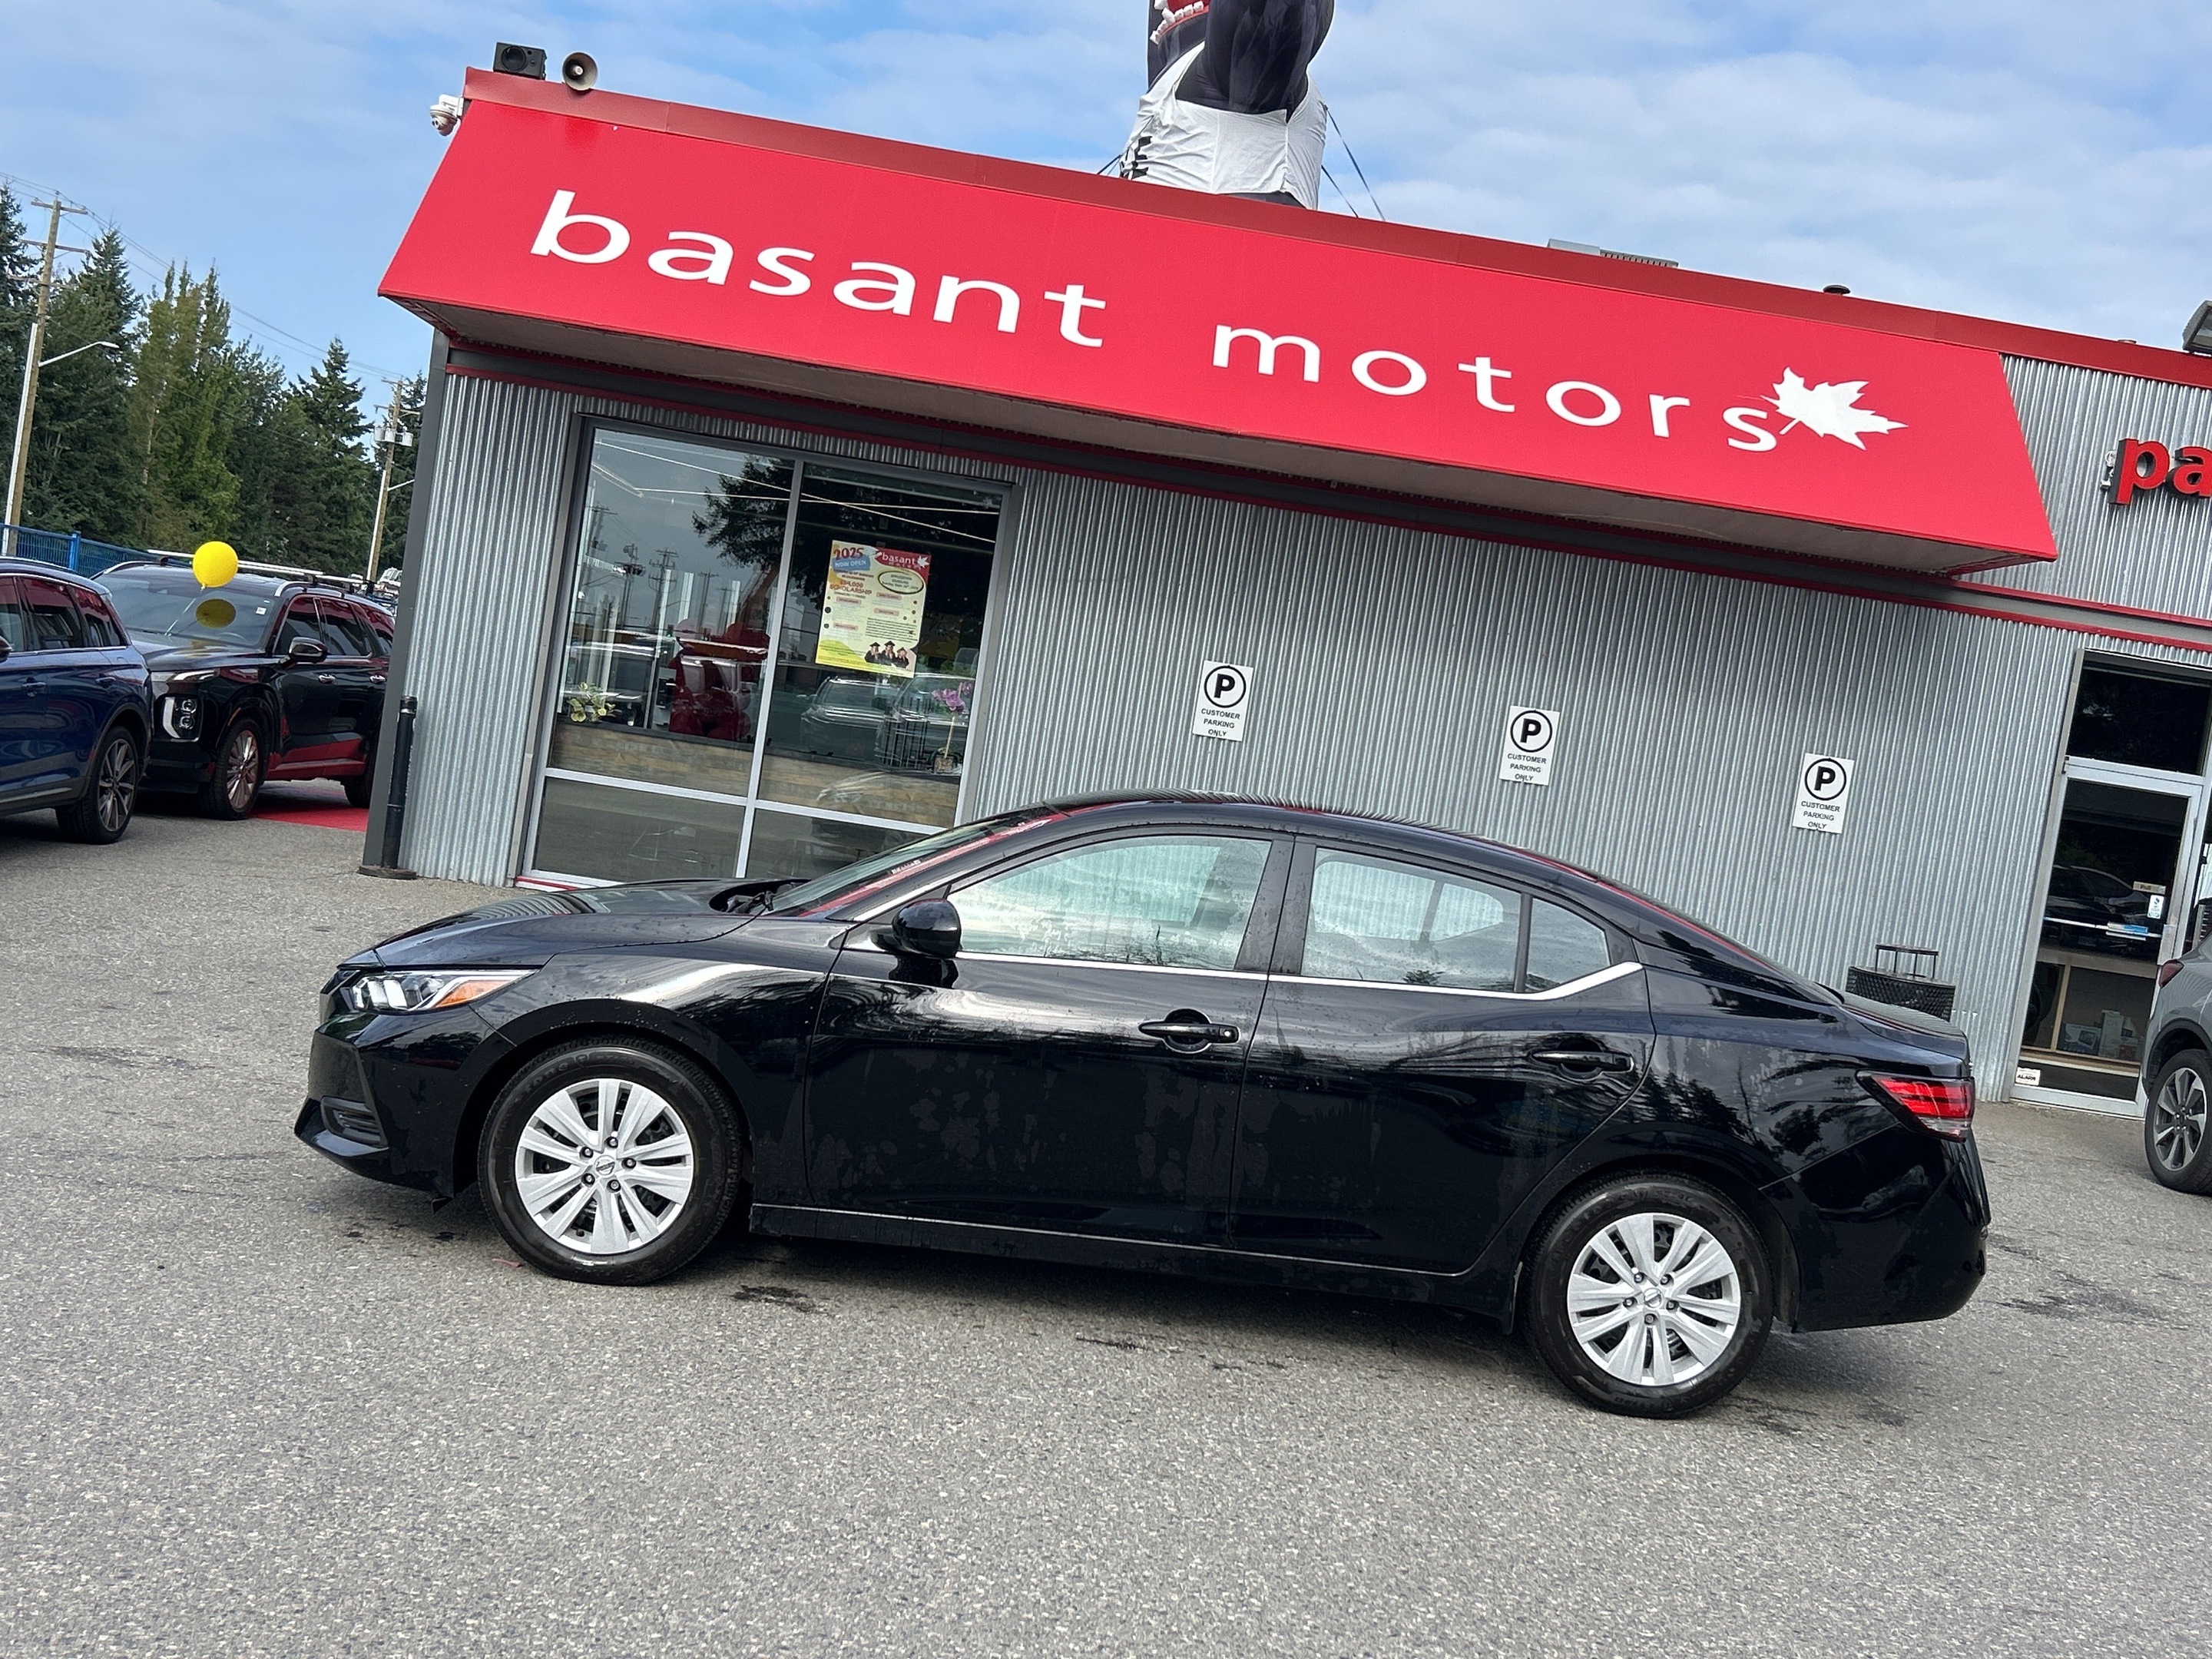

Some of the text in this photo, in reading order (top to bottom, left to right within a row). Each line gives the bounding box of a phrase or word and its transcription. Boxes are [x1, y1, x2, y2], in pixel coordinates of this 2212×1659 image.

[530, 189, 1777, 452] basant motors
[833, 547, 865, 561] 2025
[882, 552, 916, 565] basant
[1214, 674, 1235, 699] P
[1201, 708, 1240, 720] CUSTOMER
[1204, 718, 1235, 729] PARKING
[1520, 718, 1541, 743] P
[1508, 753, 1547, 764] CUSTOMER
[1510, 763, 1541, 773] PARKING
[1515, 773, 1534, 782] ONLY
[1814, 766, 1836, 791] P
[1801, 800, 1840, 813] CUSTOMER
[1803, 811, 1835, 821] PARKING
[1807, 821, 1827, 830] ONLY
